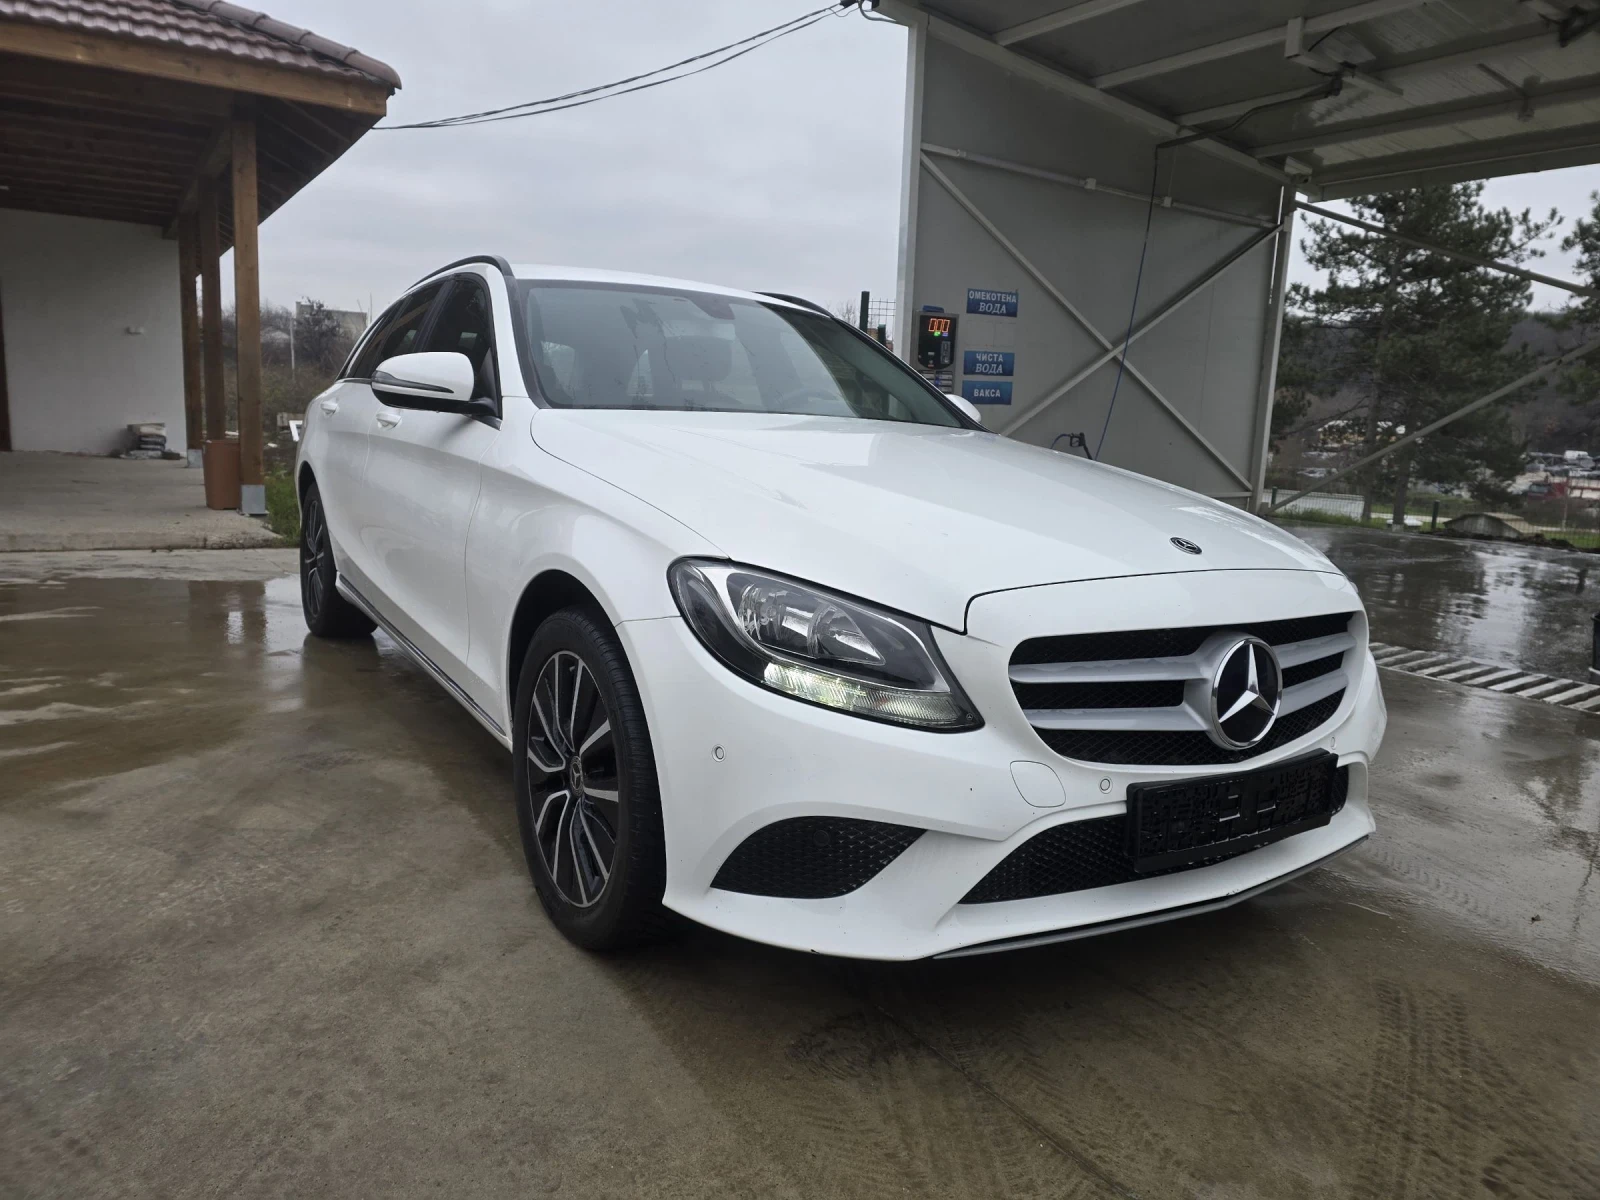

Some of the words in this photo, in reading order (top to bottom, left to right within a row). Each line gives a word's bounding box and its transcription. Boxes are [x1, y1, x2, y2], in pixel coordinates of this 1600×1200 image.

[969, 291, 1017, 303] ОМЕКОТЕНА
[979, 302, 1007, 314] ВОДА
[976, 353, 1003, 362] ЧИСТА
[975, 364, 1003, 374] ВОДА
[974, 389, 1001, 398] ВАКСА
